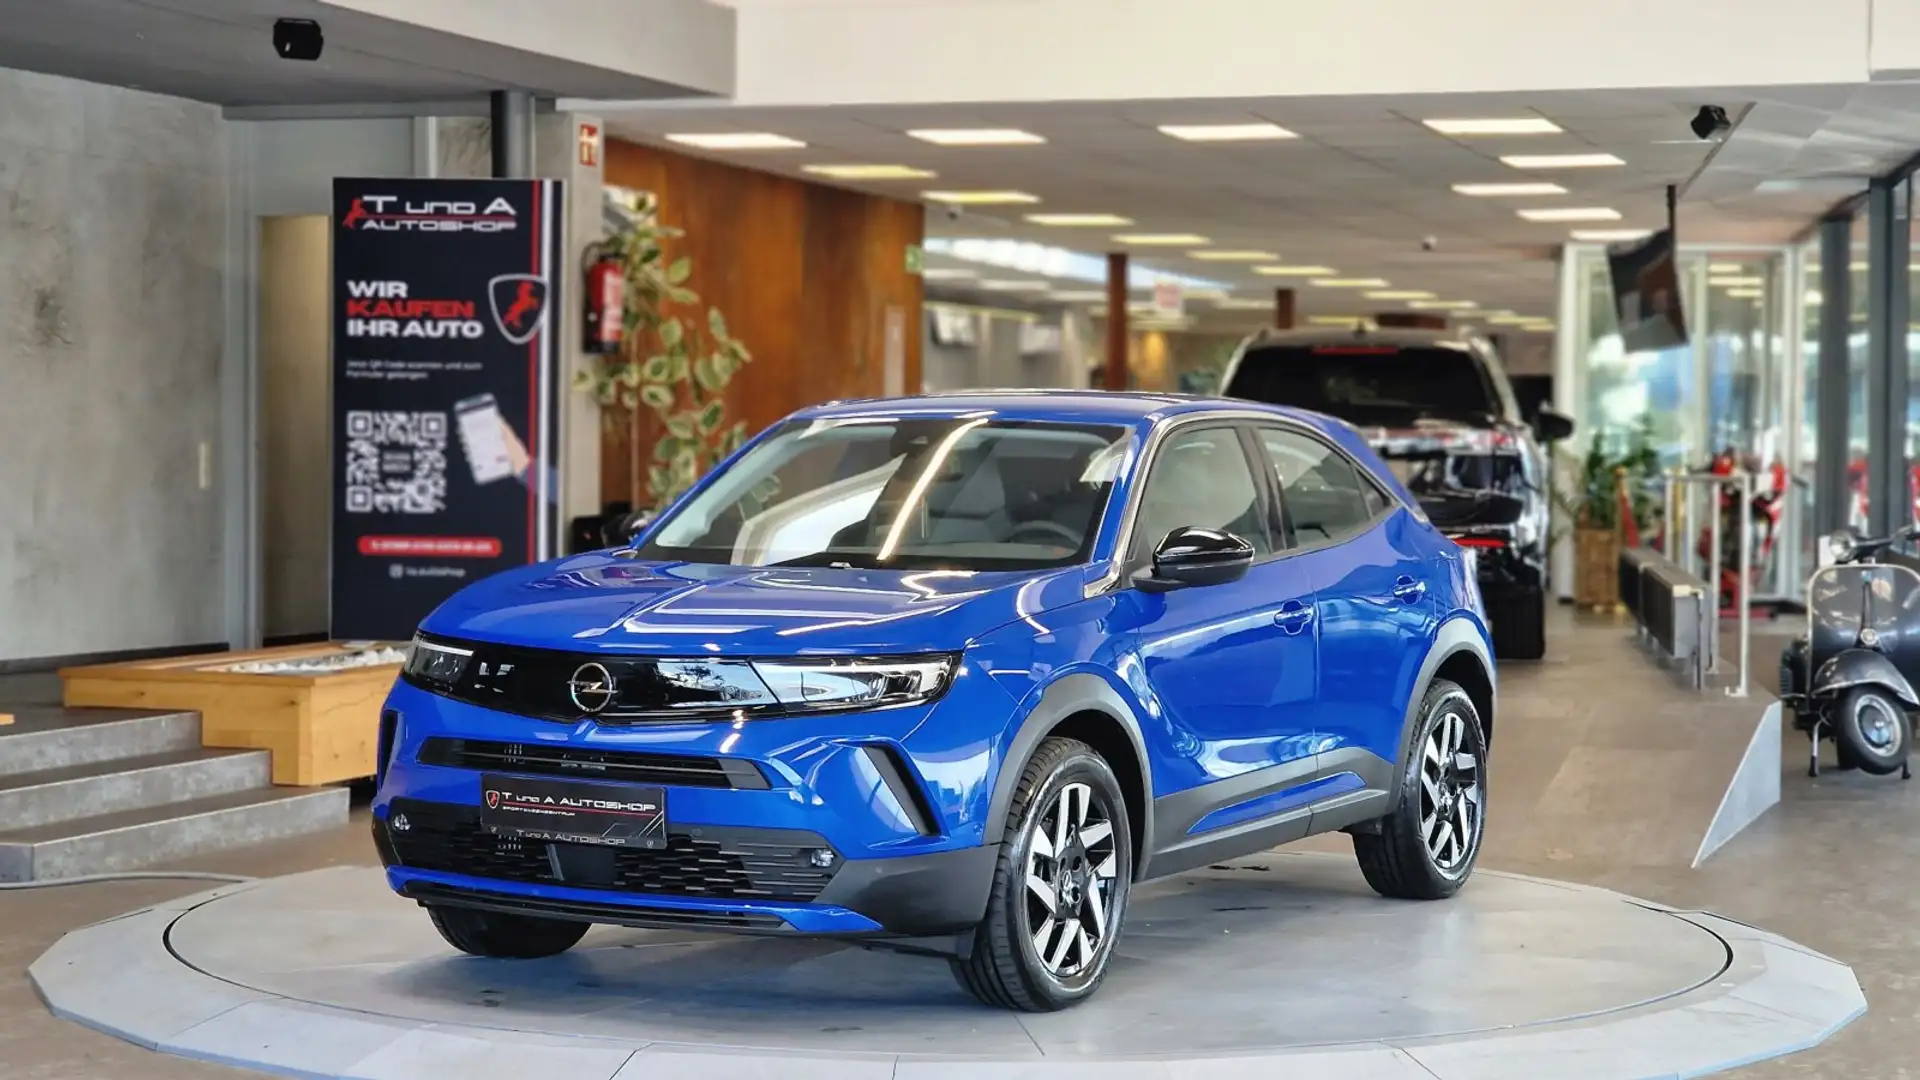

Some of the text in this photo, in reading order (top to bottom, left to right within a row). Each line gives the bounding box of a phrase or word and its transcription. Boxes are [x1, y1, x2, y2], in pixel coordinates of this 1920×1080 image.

[363, 195, 397, 213] T
[483, 197, 517, 215] A
[362, 220, 517, 231] AUTOSHOP
[347, 280, 408, 297] WIR
[347, 300, 475, 318] KAUFEN
[347, 319, 484, 338] IHR AUTO
[502, 791, 513, 800] T
[543, 796, 556, 804] A
[559, 797, 656, 811] AUTOSHOP
[516, 829, 525, 837] T
[542, 831, 551, 839] A
[555, 833, 626, 846] AUTOSHOP
